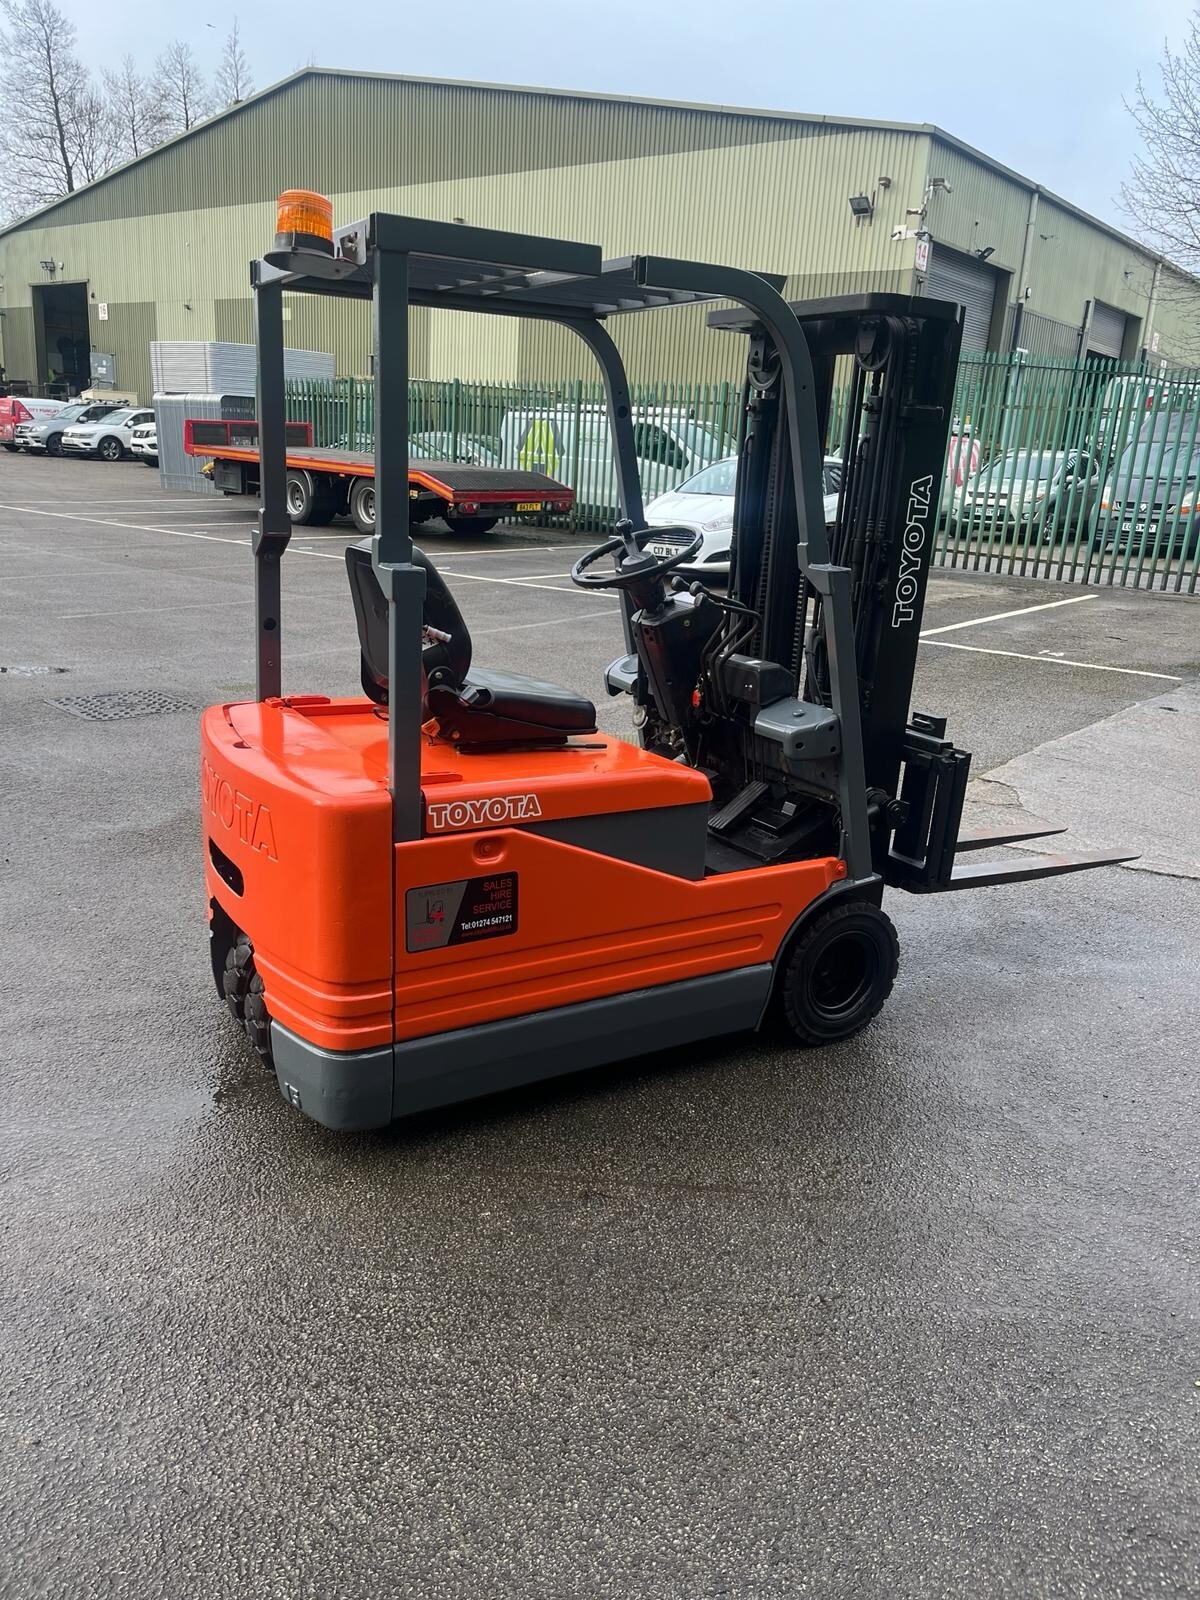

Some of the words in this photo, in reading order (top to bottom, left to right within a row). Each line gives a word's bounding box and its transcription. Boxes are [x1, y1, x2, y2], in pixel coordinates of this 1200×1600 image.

[653, 546, 664, 555] C17
[892, 474, 933, 628] TOYOTA
[201, 757, 279, 863] OYOTA
[428, 793, 542, 828] TOYOTA
[483, 879, 513, 891] SALES
[490, 889, 513, 901] HIRE
[473, 899, 513, 914] SERVICE
[491, 914, 513, 926] 547121
